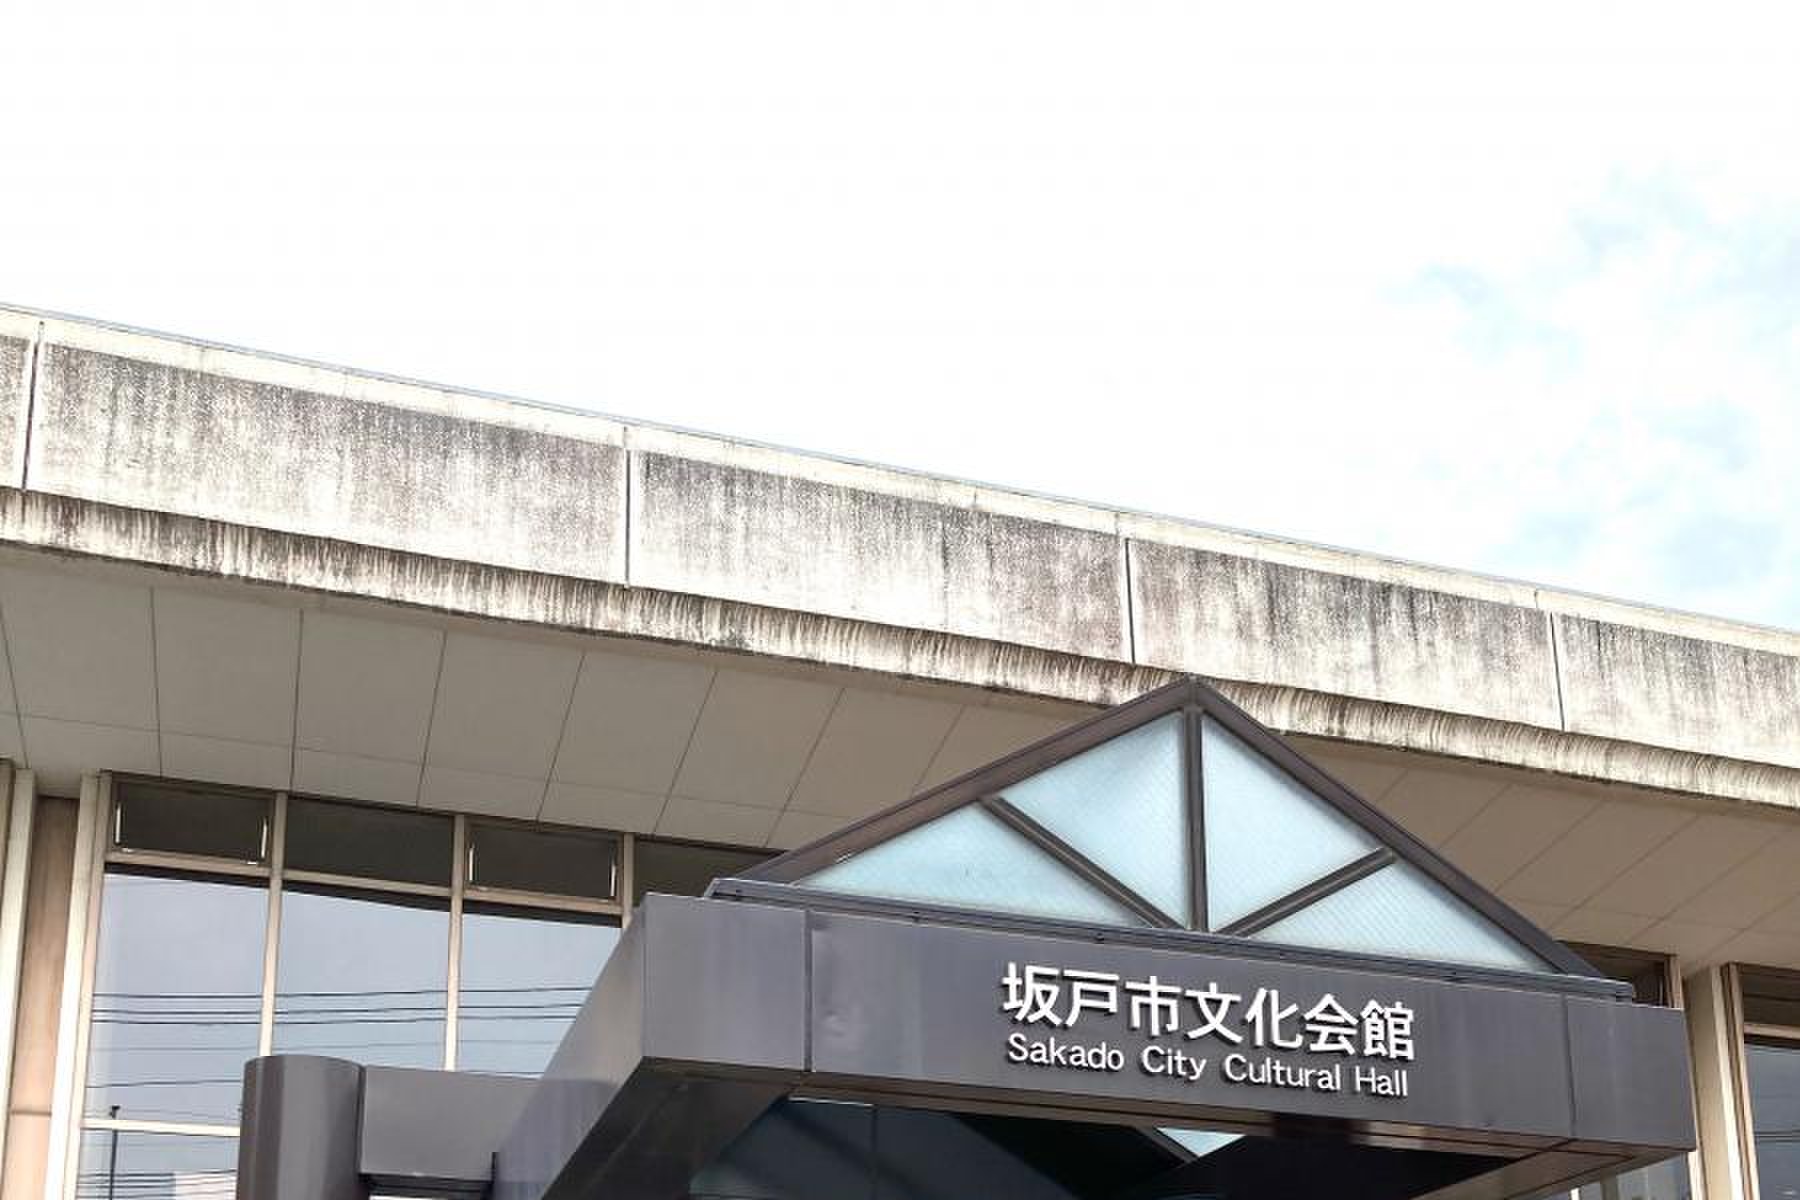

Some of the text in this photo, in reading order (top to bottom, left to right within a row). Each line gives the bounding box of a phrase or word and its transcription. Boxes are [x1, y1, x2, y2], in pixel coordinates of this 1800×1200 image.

[1002, 961, 1415, 1061] 坂戸市文化会館
[1008, 1033, 1408, 1097] Sakado City Cultural Hall
